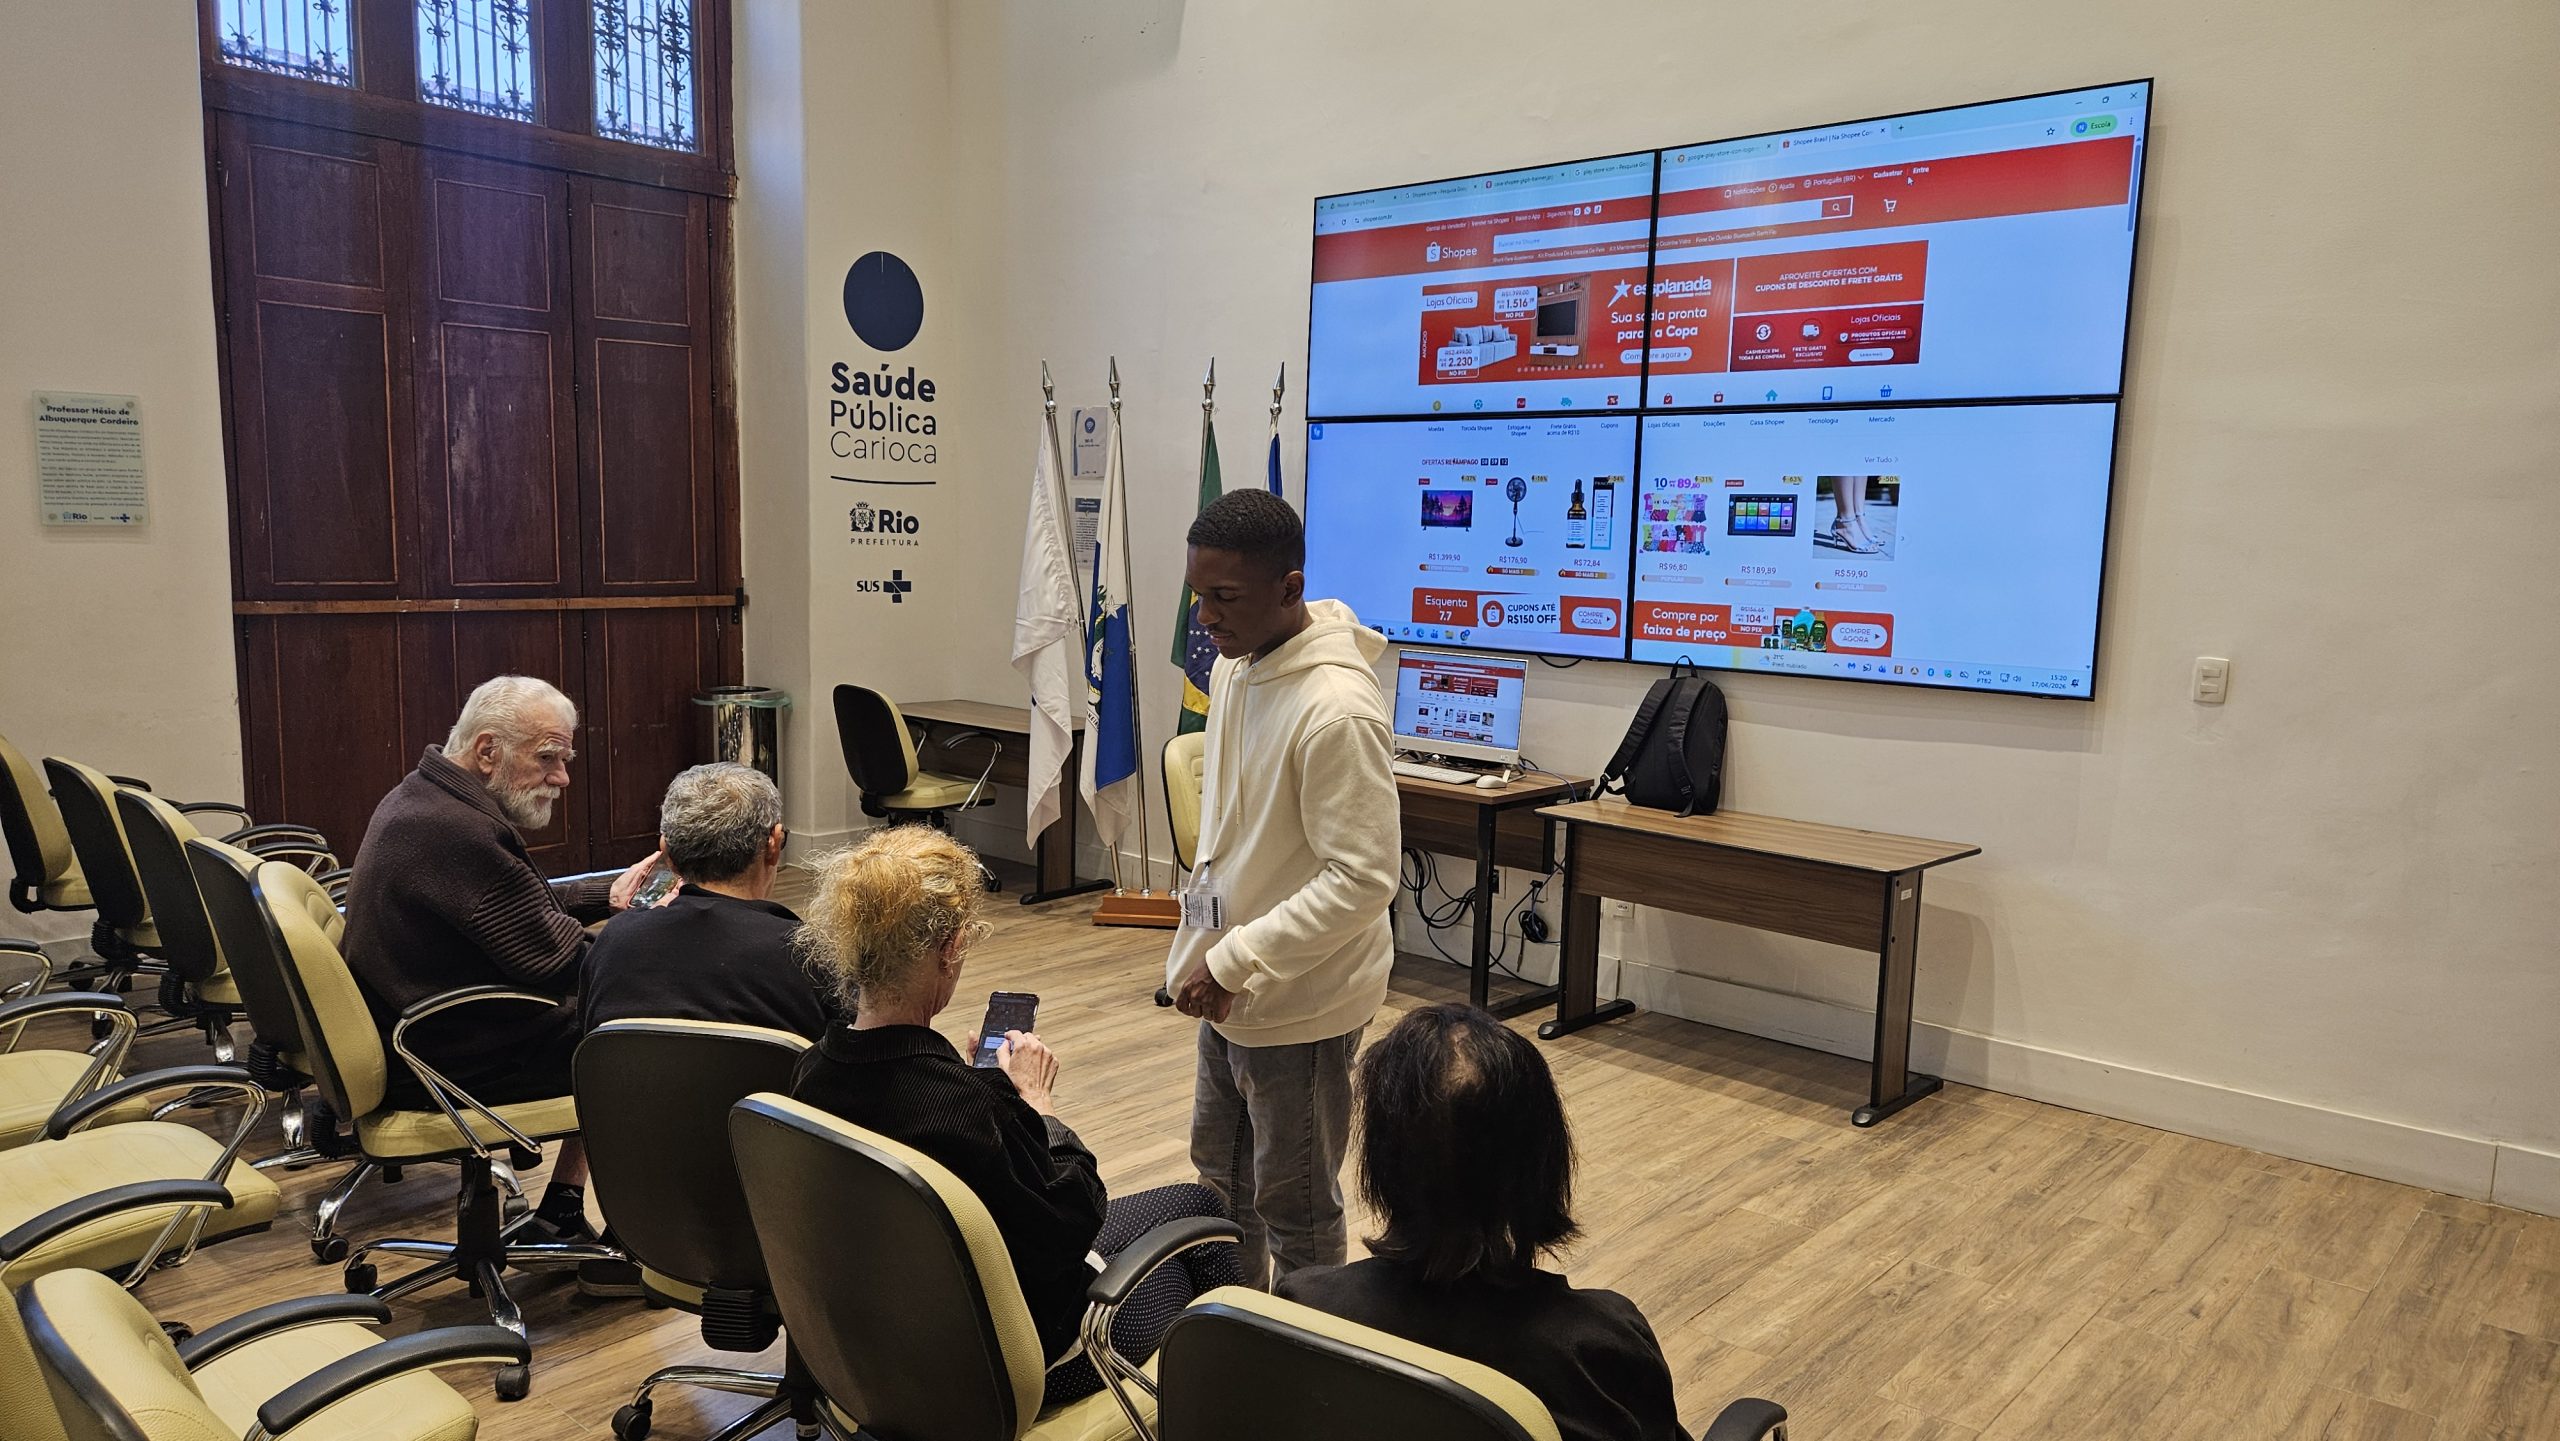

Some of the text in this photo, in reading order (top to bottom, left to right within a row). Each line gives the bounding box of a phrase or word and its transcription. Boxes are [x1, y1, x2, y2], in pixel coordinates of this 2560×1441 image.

[2090, 120, 2111, 130] Escola
[1793, 130, 1860, 147] Shopee Brasil Na Shopee
[1873, 169, 1903, 179] Cadastrar
[1813, 176, 1842, 188] Português
[1442, 245, 1478, 261] Shopee
[1779, 266, 1878, 281] APROVEITE OFERTAS COM
[1755, 283, 1786, 293] CUPONS
[1787, 282, 1798, 290] DE
[1798, 278, 1840, 289] DESCONTO
[1848, 276, 1872, 286] FRETE
[1873, 272, 1903, 283] GRÁTIS
[1426, 295, 1473, 309] Lojas Oficiais
[1506, 298, 1528, 309] 1.516
[1505, 311, 1514, 319] NO
[1611, 311, 1633, 324] Sua
[1667, 307, 1708, 323] pronta
[1850, 314, 1901, 325] Lojas Oficiais
[1617, 325, 1699, 344] para a Copa
[1660, 350, 1681, 361] agora
[1448, 356, 1473, 367] 2.230
[830, 361, 936, 403] Saúde
[46, 405, 130, 416] Professor Hésio de
[39, 414, 139, 426] Albuquerque Cordeiro
[830, 399, 937, 436] Pública
[1764, 418, 1785, 427] Shopee
[1808, 417, 1839, 426] Tecnologia
[1868, 415, 1895, 423] Mercado
[1703, 419, 1726, 429] Doações
[830, 430, 937, 465] Carioca
[1864, 456, 1893, 464] Ver Tudo
[1654, 477, 1668, 488] 10
[72, 512, 88, 520] Rio
[878, 509, 920, 535] Rio
[850, 537, 919, 546] PREFEITURA
[856, 580, 880, 593] SUS
[1425, 594, 1468, 611] Esquenta
[1507, 602, 1556, 612] CUPONS ATÉ
[1439, 610, 1453, 622] 7.7
[1507, 614, 1557, 625] R$150 OFF
[1578, 610, 1604, 619] COMPRE
[1652, 607, 1697, 623] Compre
[1699, 611, 1719, 624] por
[1746, 614, 1761, 623] 104
[1580, 617, 1602, 625] AGORA
[1642, 622, 1727, 642] faixa de preço
[1839, 626, 1871, 636] COMPRE
[1842, 635, 1869, 644] AGORA
[2031, 681, 2067, 690] 17/06/2026
